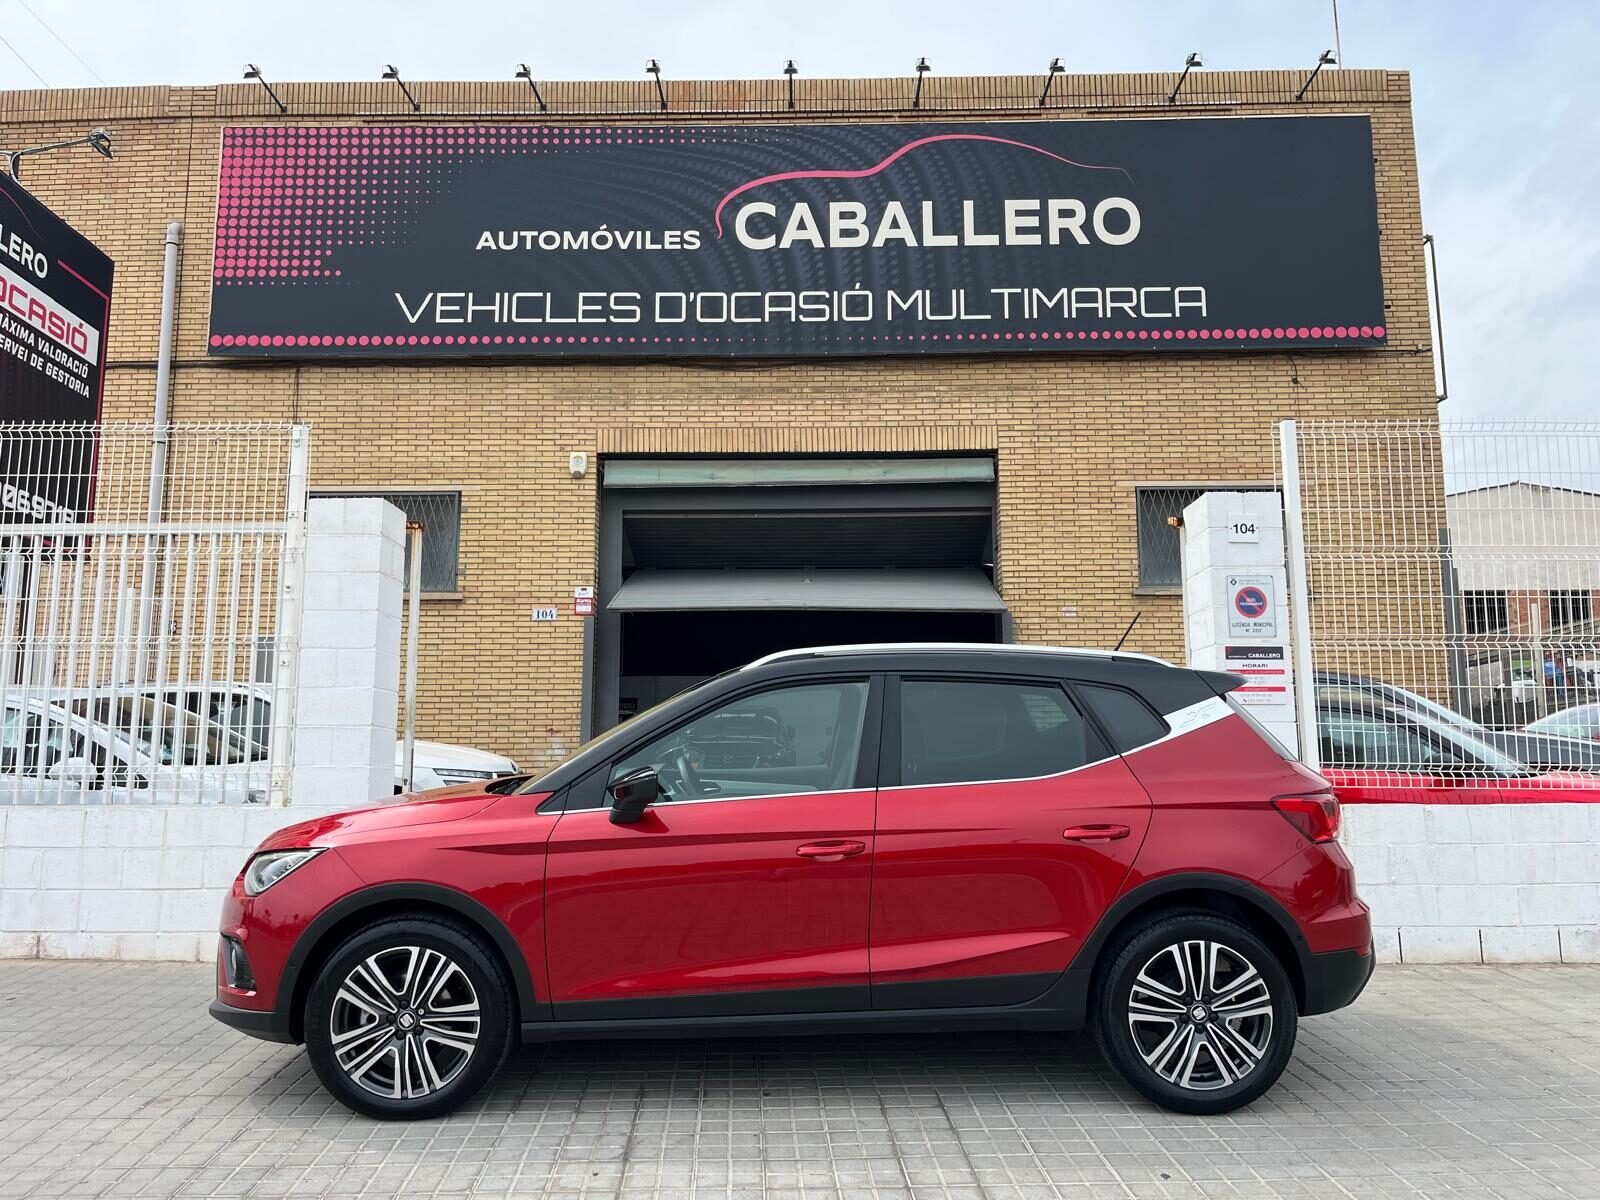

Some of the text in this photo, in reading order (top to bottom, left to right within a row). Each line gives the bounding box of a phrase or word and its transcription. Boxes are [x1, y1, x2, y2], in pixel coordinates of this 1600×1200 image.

[476, 197, 1141, 250] AUTOMÓVILES CABALLERO
[395, 283, 1207, 324] VEHICLES D'OCASIÓ MULTIMARCA
[0, 312, 89, 379] ÀXIMA VALORACIÓ
[30, 351, 43, 371] DE
[46, 362, 90, 399] GESTORIA
[1232, 523, 1256, 534] 104
[536, 611, 554, 619] 104
